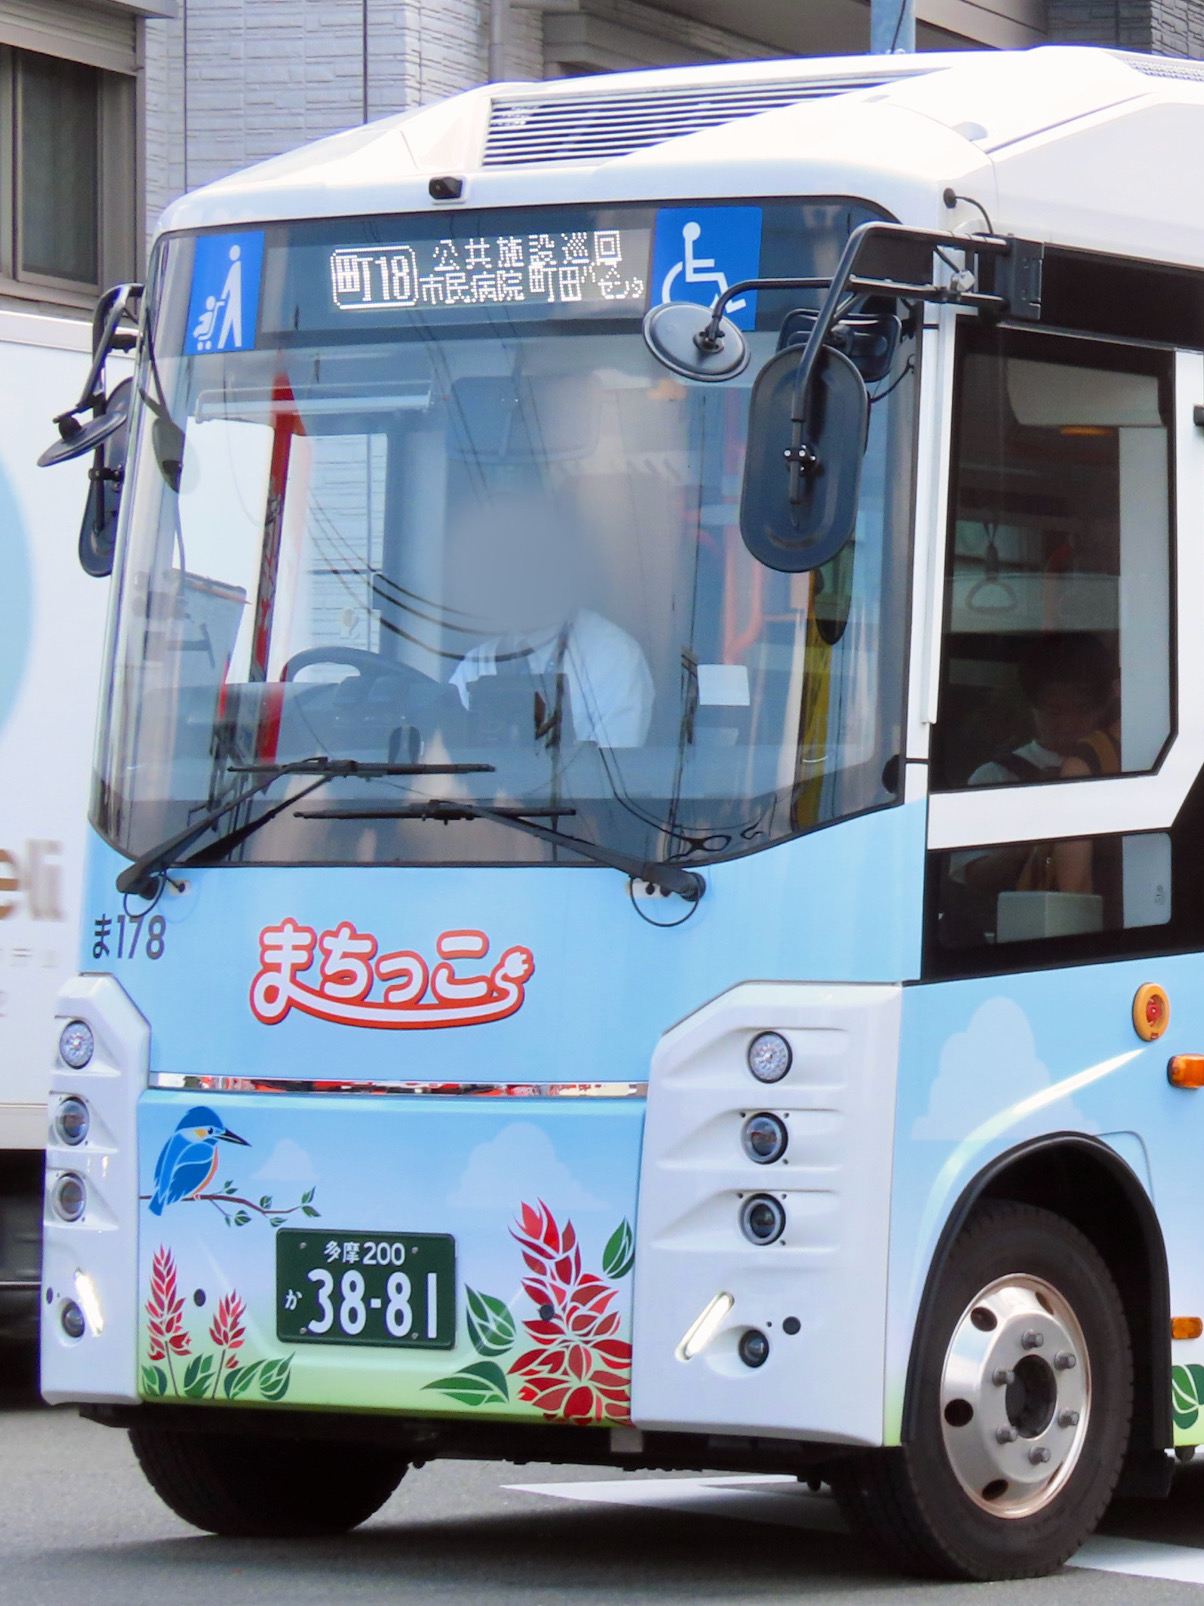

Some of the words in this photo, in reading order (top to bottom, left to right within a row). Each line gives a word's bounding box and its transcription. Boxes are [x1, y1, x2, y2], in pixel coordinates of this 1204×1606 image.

[432, 230, 622, 270] 公共施設巡回
[336, 254, 410, 302] 町18
[419, 270, 525, 305] 市民病院
[92, 913, 166, 960] ま178
[249, 917, 534, 1030] まちっこ
[285, 1289, 303, 1311] か
[307, 1268, 438, 1339] 38-81
